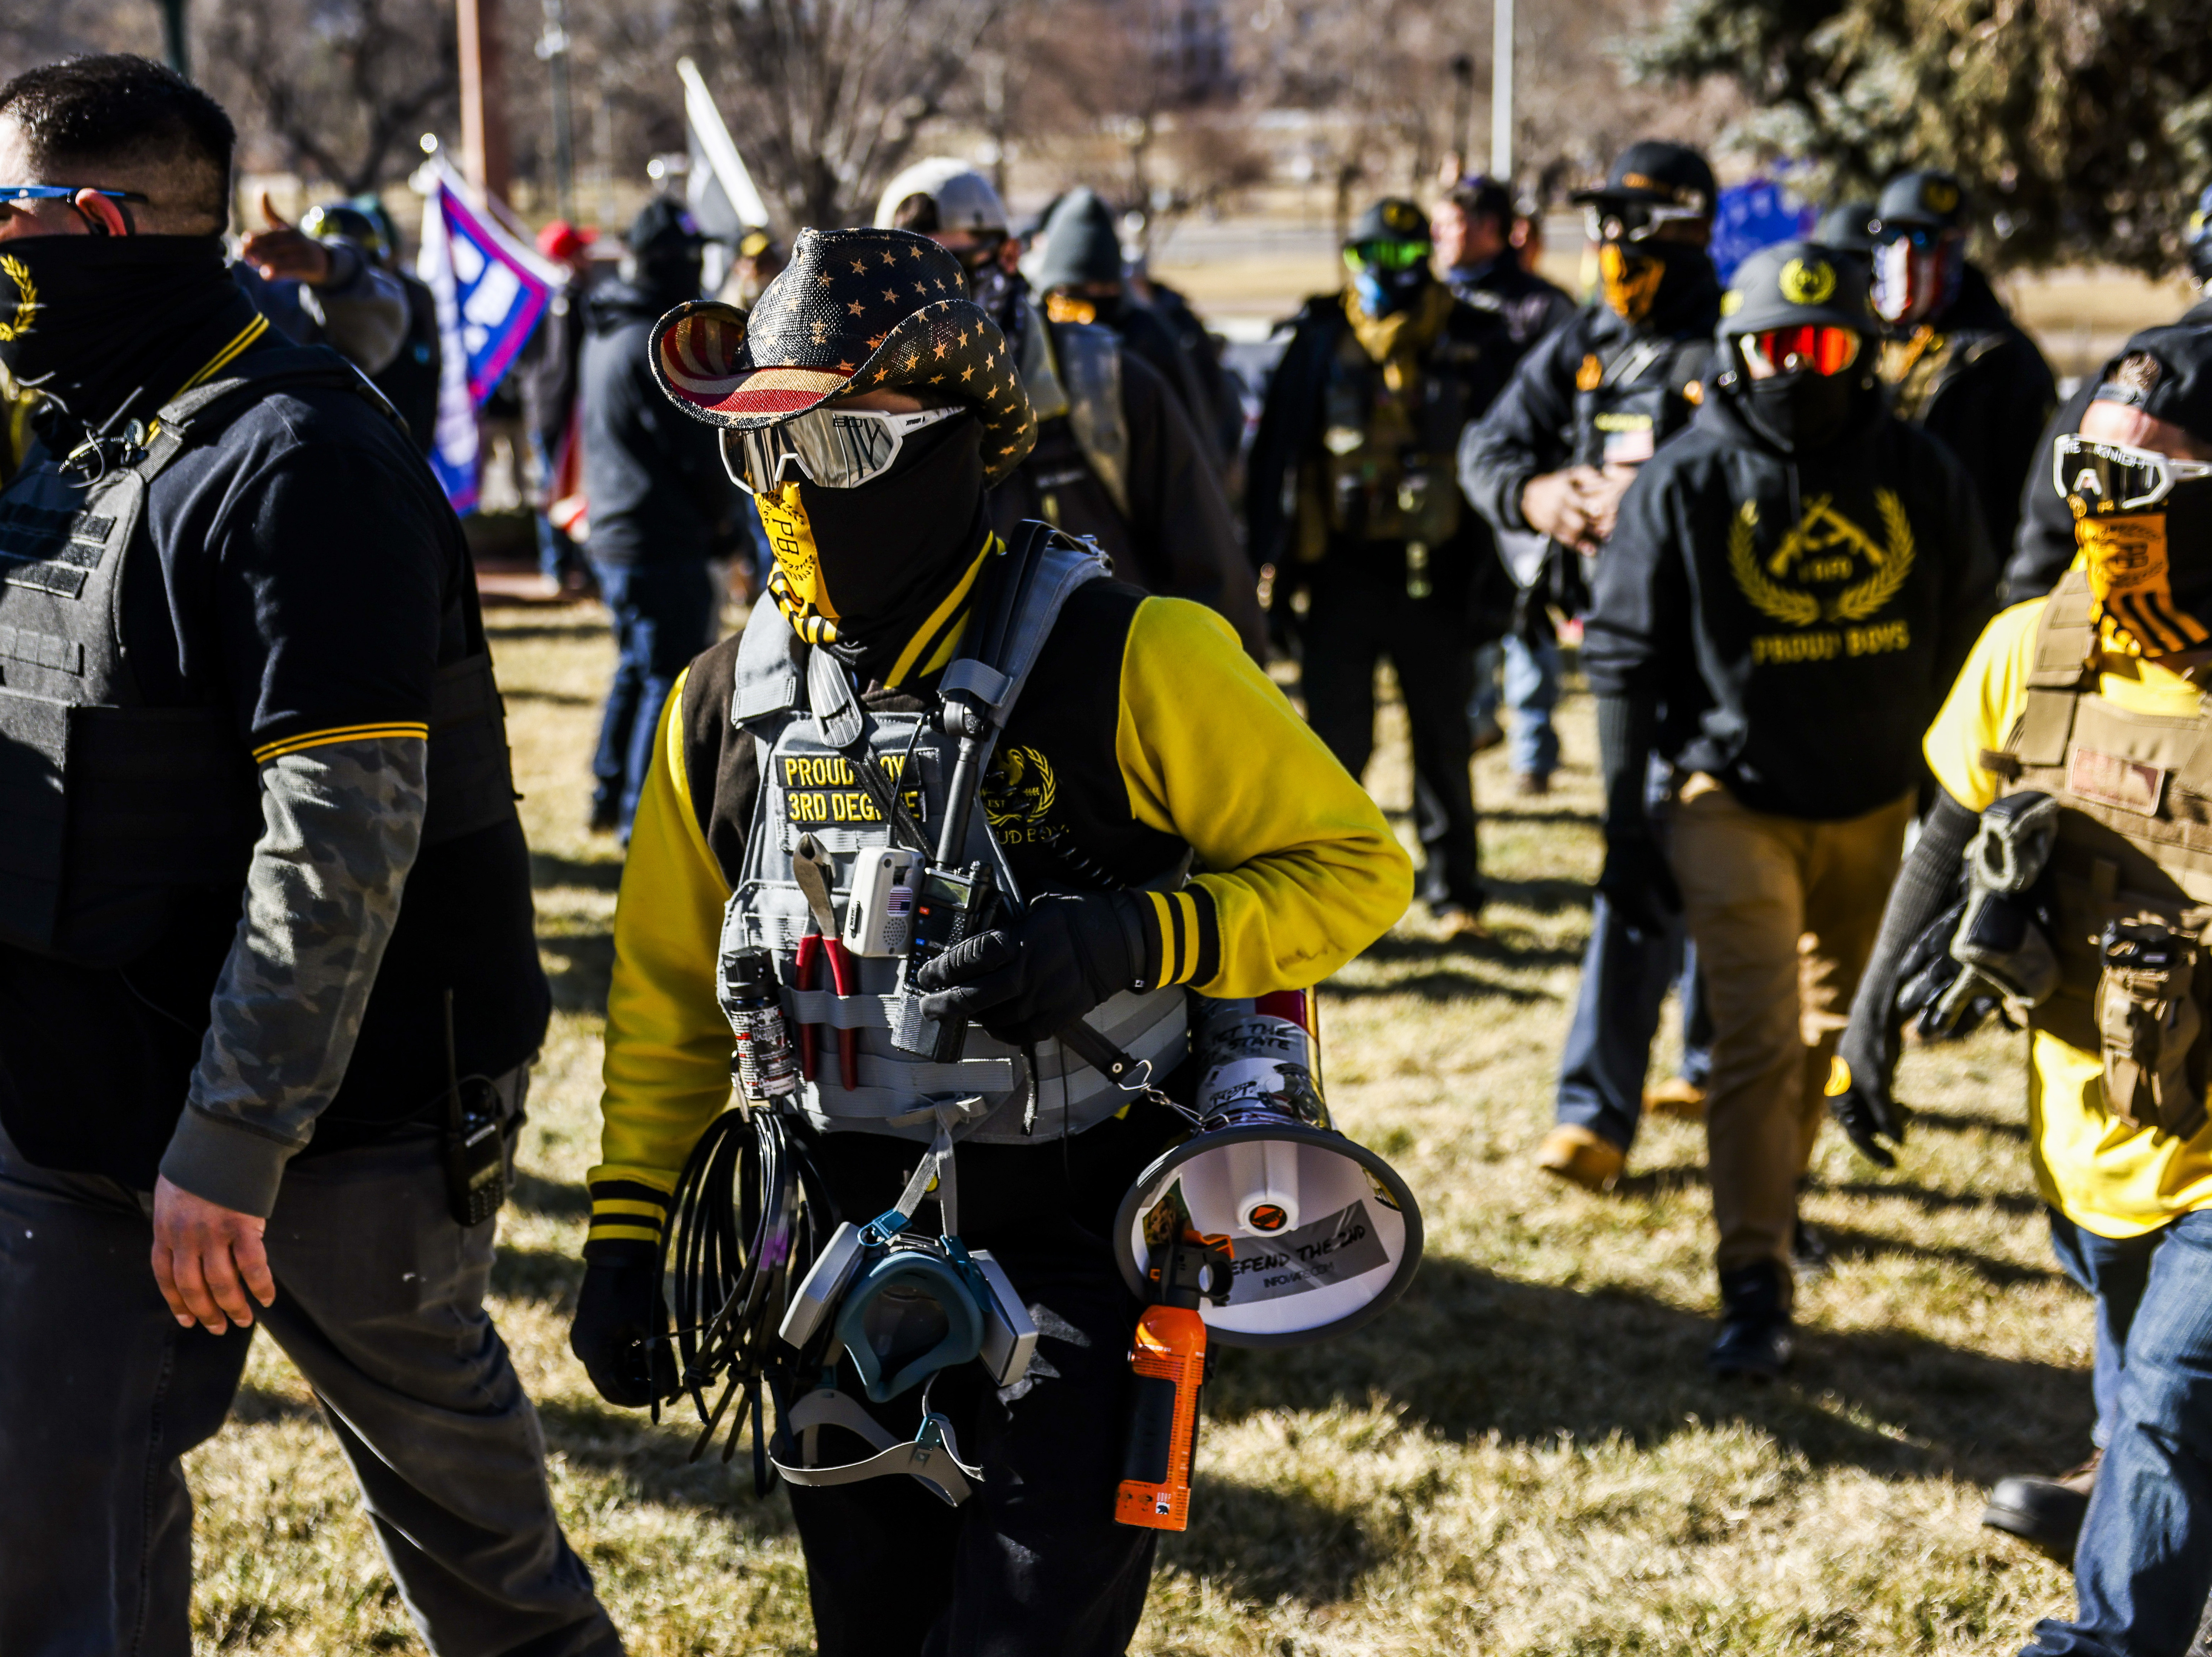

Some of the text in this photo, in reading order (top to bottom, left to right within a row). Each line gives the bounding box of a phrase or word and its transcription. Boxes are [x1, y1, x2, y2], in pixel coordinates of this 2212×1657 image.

[833, 418, 881, 462] BOY
[772, 518, 799, 556] PB
[785, 758, 854, 786] PROUD
[788, 791, 920, 821] 3RD DEGE
[1231, 1225, 1366, 1276] EFEND THE 2ND
